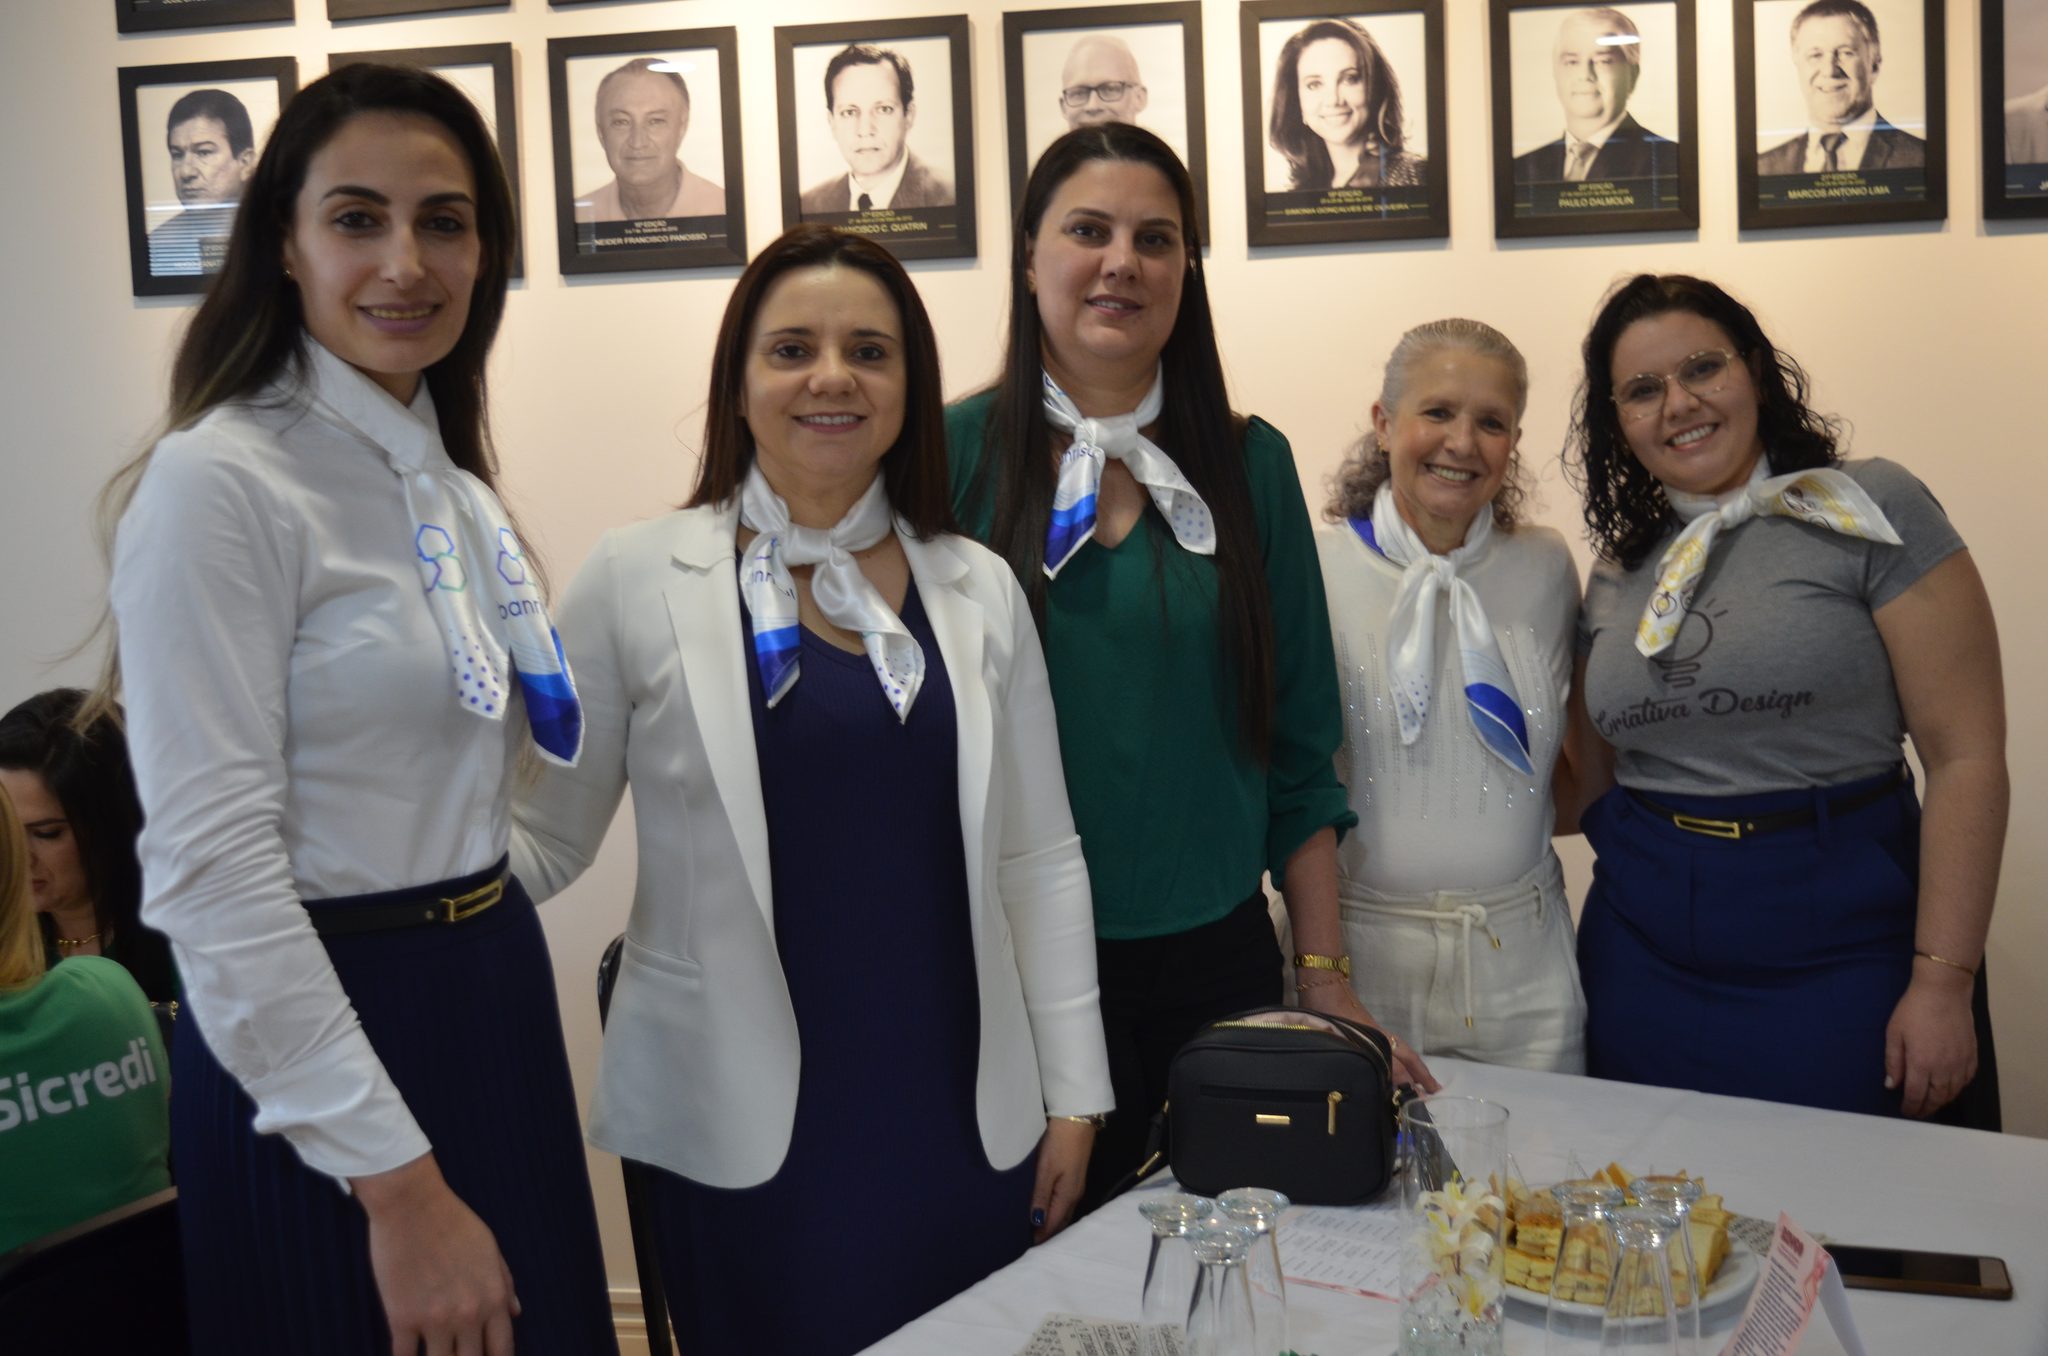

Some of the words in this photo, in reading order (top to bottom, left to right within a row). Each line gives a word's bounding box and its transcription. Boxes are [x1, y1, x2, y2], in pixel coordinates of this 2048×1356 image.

[1787, 189, 1828, 199] MARCOS
[1828, 187, 1868, 198] ANTONIO
[1868, 185, 1891, 195] LIMA
[1558, 197, 1588, 208] PAULO
[1589, 195, 1635, 207] DALMOLIN
[890, 221, 928, 232] QUATRIN
[595, 237, 624, 247] NEIDER
[624, 235, 669, 245] FRANCISCO
[1595, 696, 1690, 737] Criativa
[1699, 688, 1812, 719] Design
[0, 1037, 156, 1132] Sicredi
